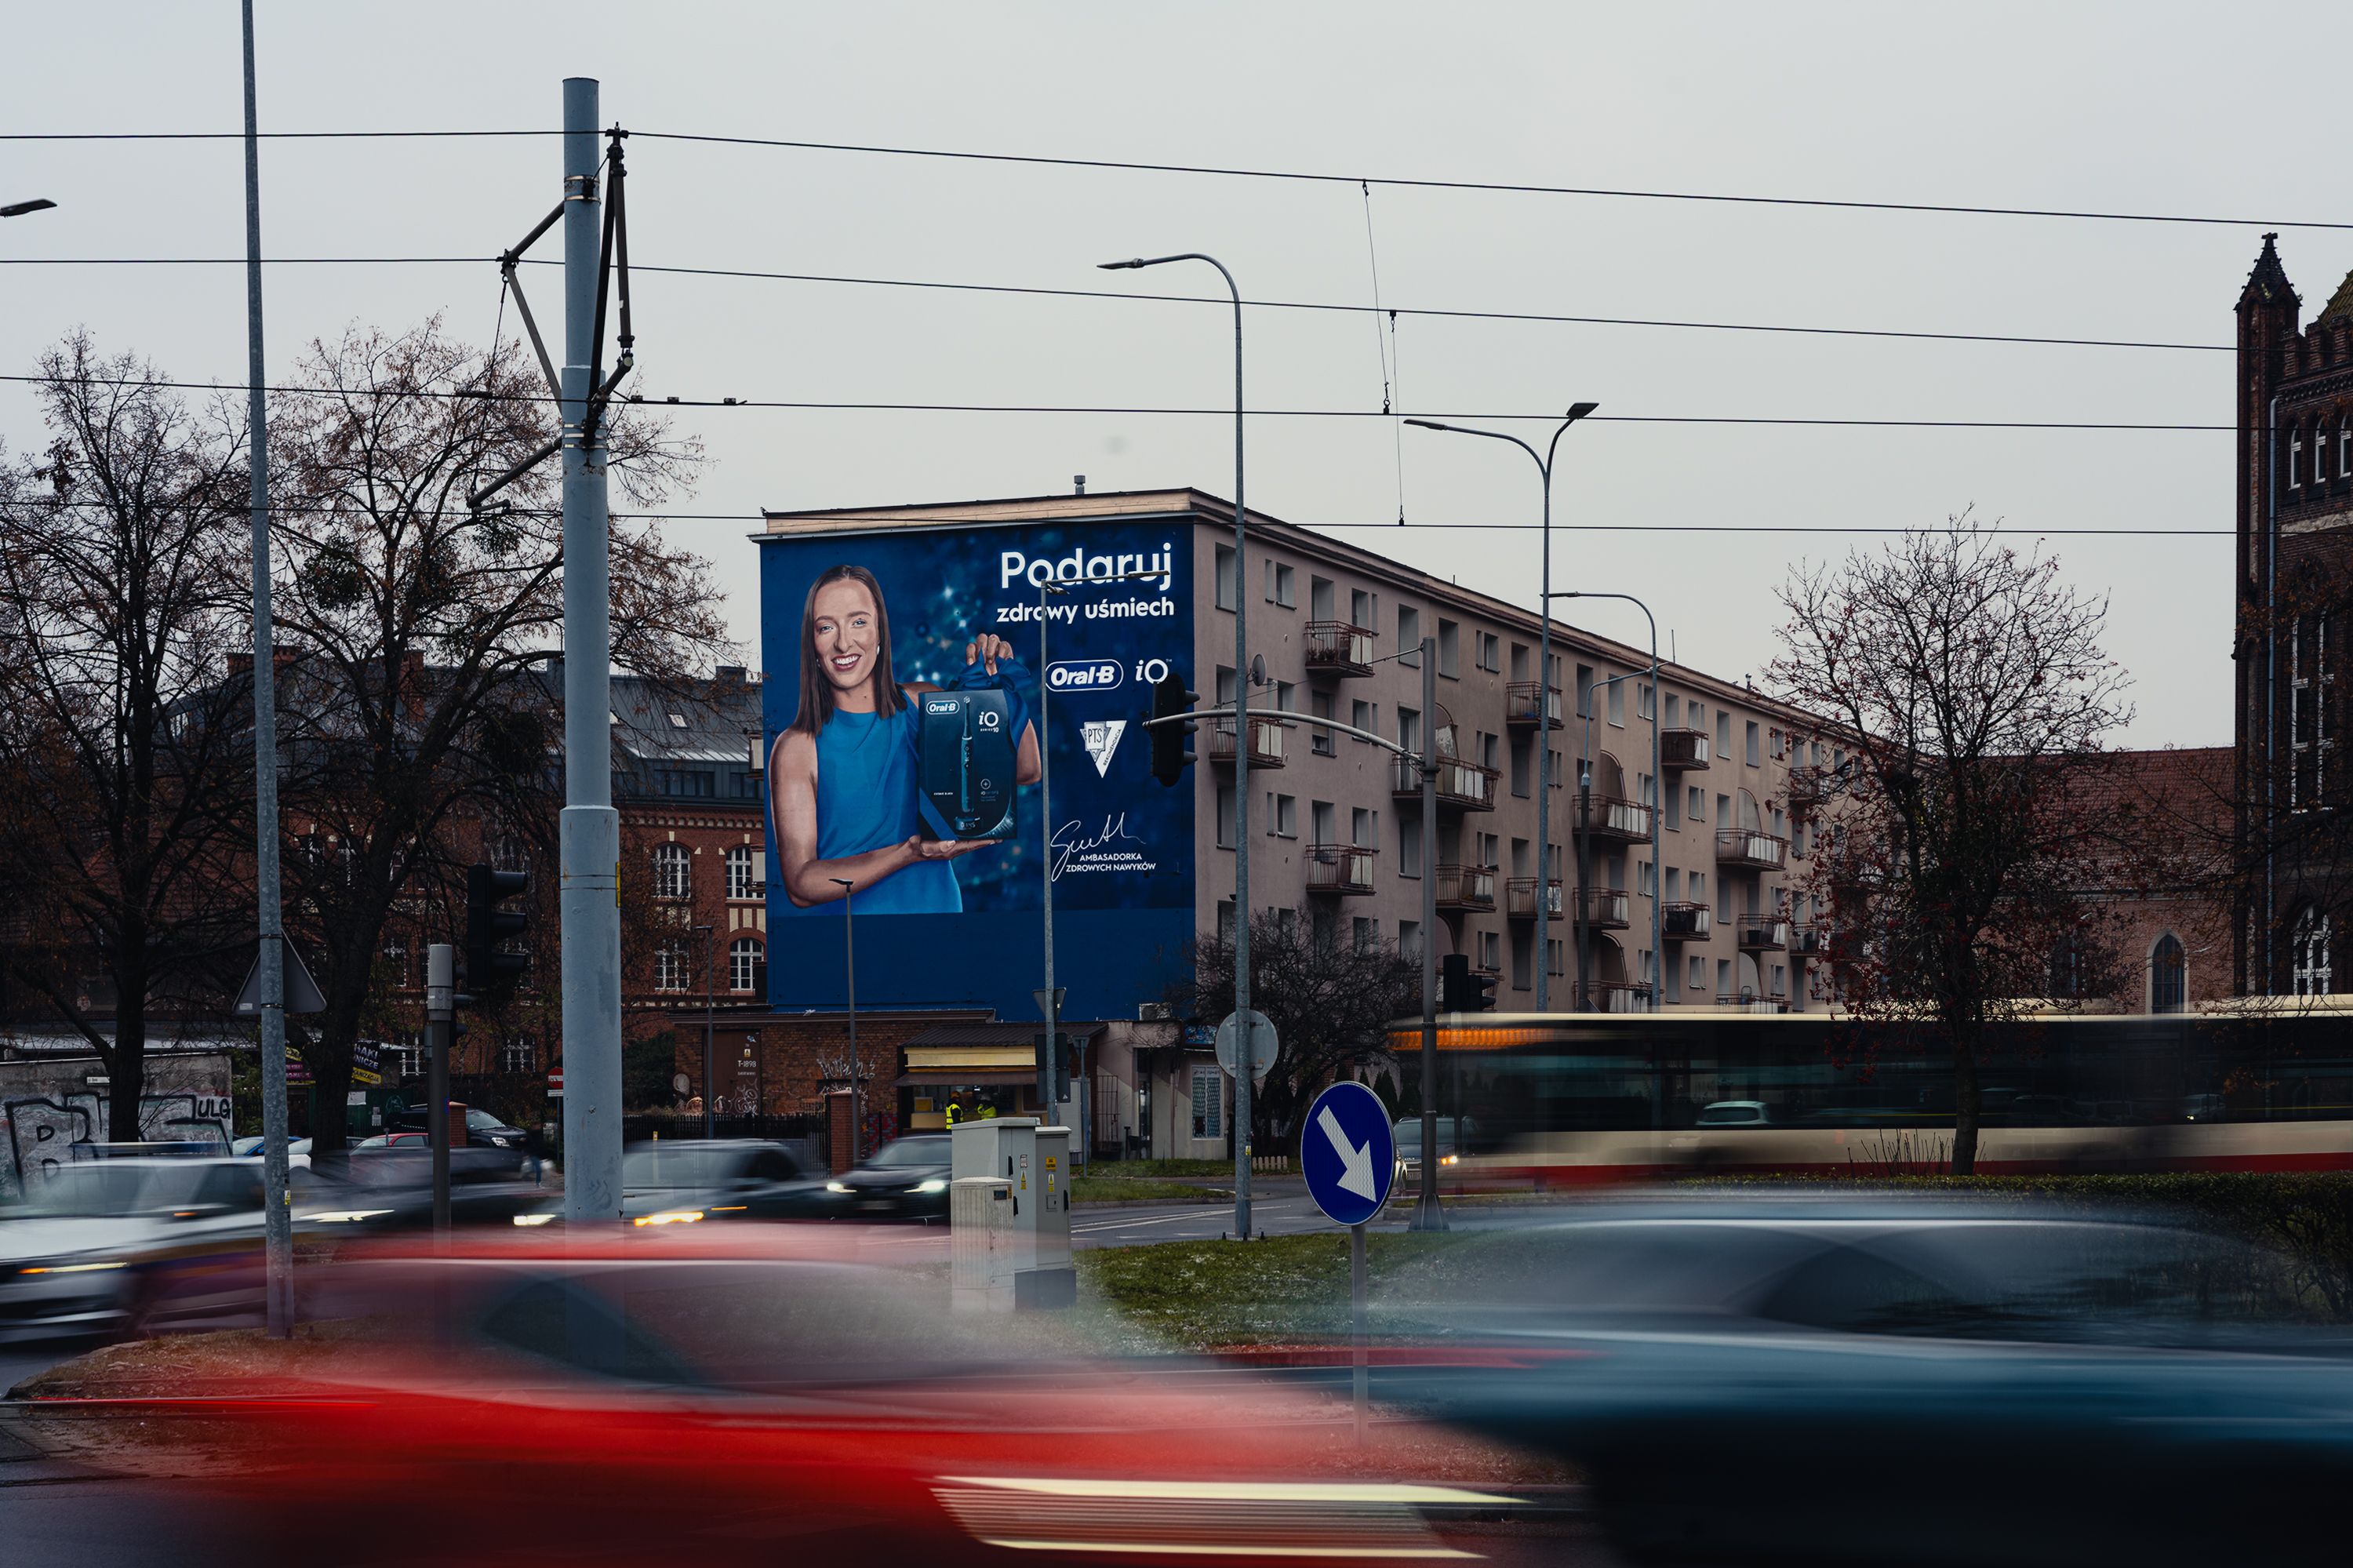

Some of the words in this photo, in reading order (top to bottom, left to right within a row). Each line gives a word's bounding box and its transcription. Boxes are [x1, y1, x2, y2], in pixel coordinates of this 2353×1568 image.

[1002, 543, 1171, 591] Podaruj
[996, 602, 1078, 624] zdrowy
[1085, 597, 1174, 619] uśmiech
[1051, 666, 1115, 686] Oral-B
[929, 703, 956, 712] Oral-B
[979, 711, 998, 727] iO
[1088, 728, 1103, 744] PTS
[1079, 853, 1142, 862] AMBASADORKA
[1066, 864, 1111, 872] ZDROWYCH
[1114, 861, 1156, 871] NAWYKÓW
[352, 1054, 380, 1069] NICZE
